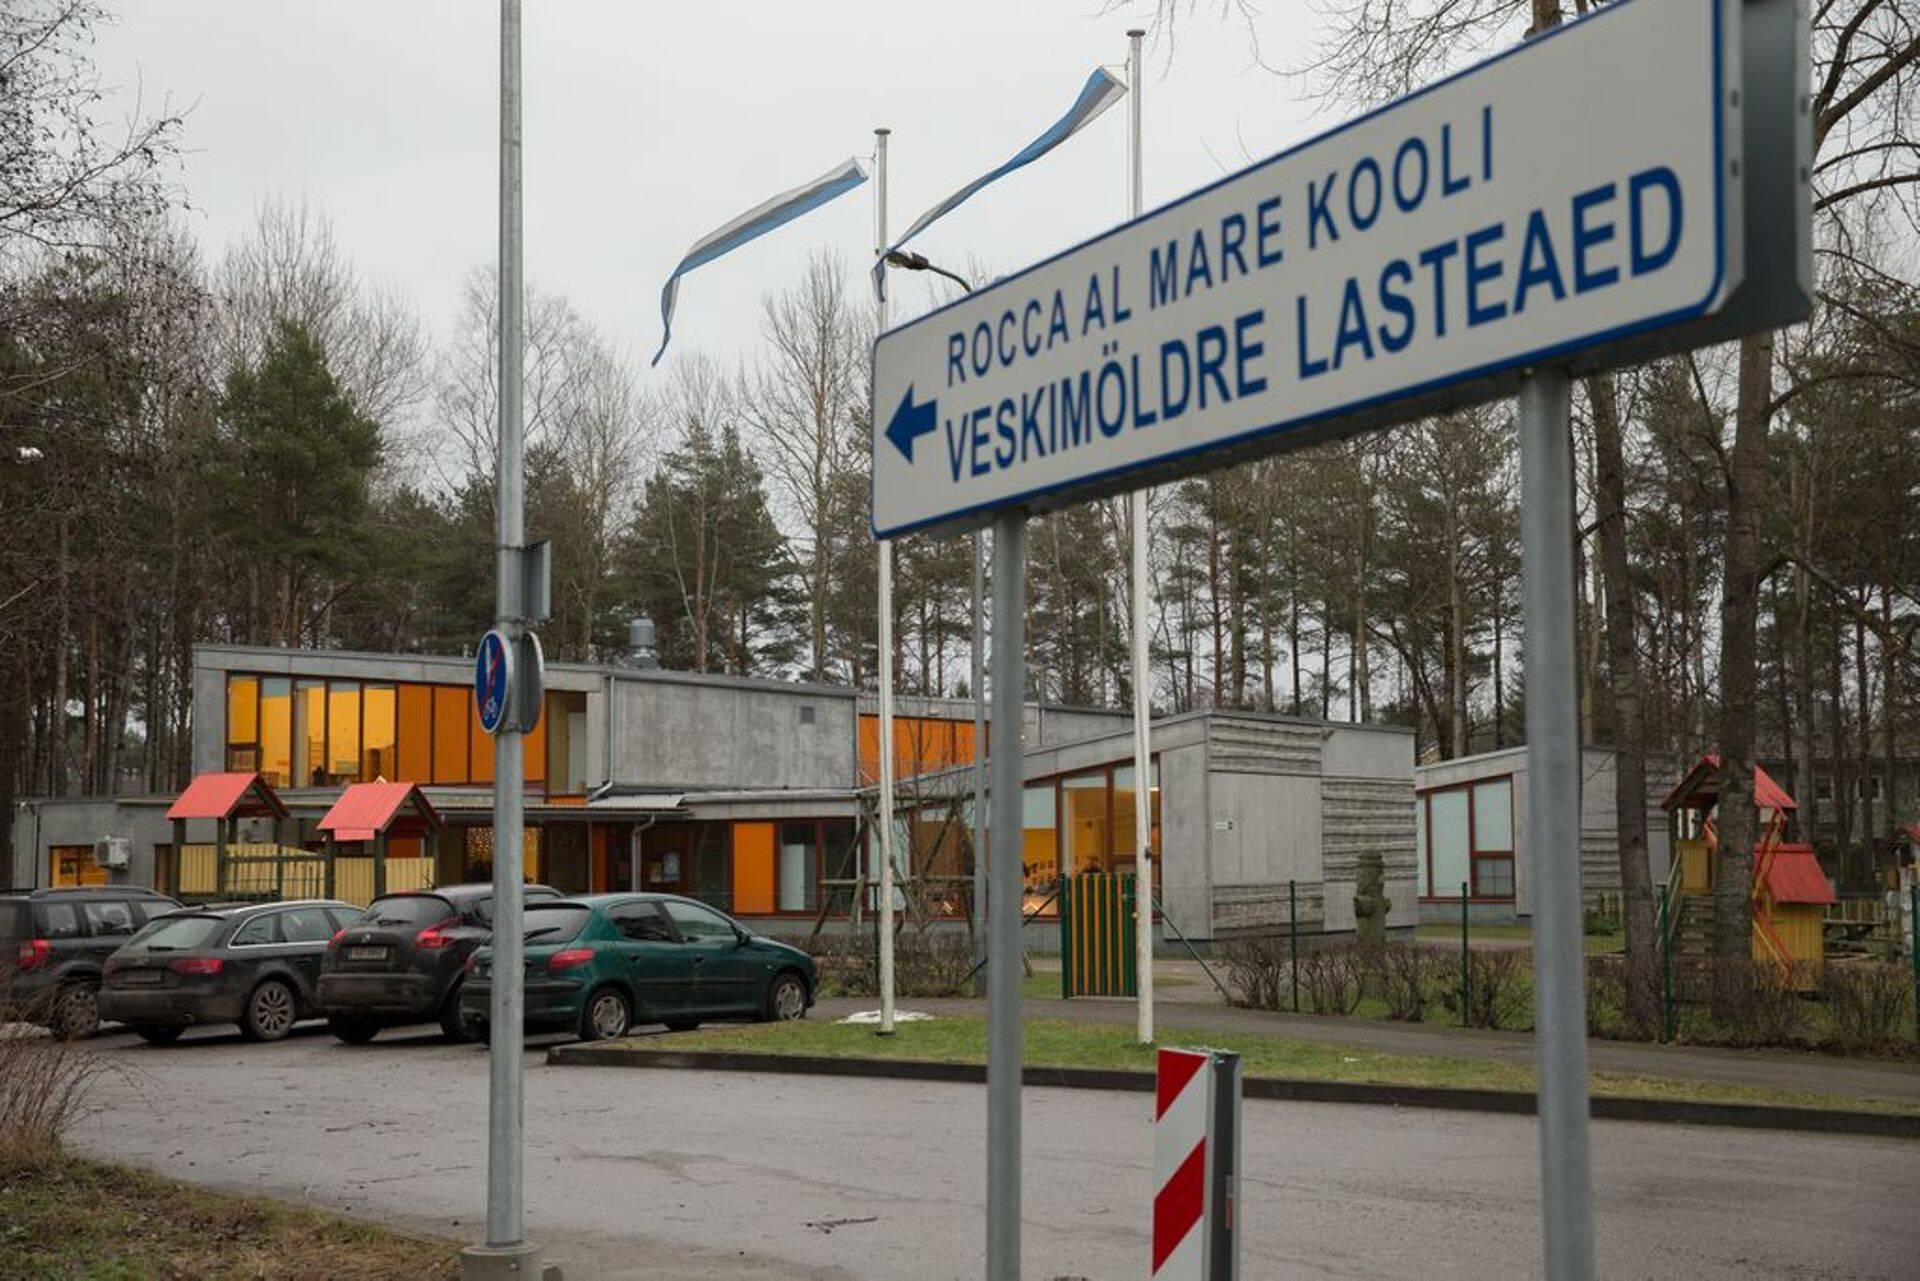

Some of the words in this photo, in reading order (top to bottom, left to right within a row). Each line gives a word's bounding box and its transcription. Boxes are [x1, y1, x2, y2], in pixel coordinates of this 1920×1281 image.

[945, 308, 1268, 484] VESKIMÖLDRE
[1296, 165, 1685, 380] LASTEAED
[948, 288, 1070, 388] ROCCA
[1083, 264, 1131, 336] AL
[1150, 195, 1284, 310] MARE
[1308, 104, 1493, 250] KOOLI
